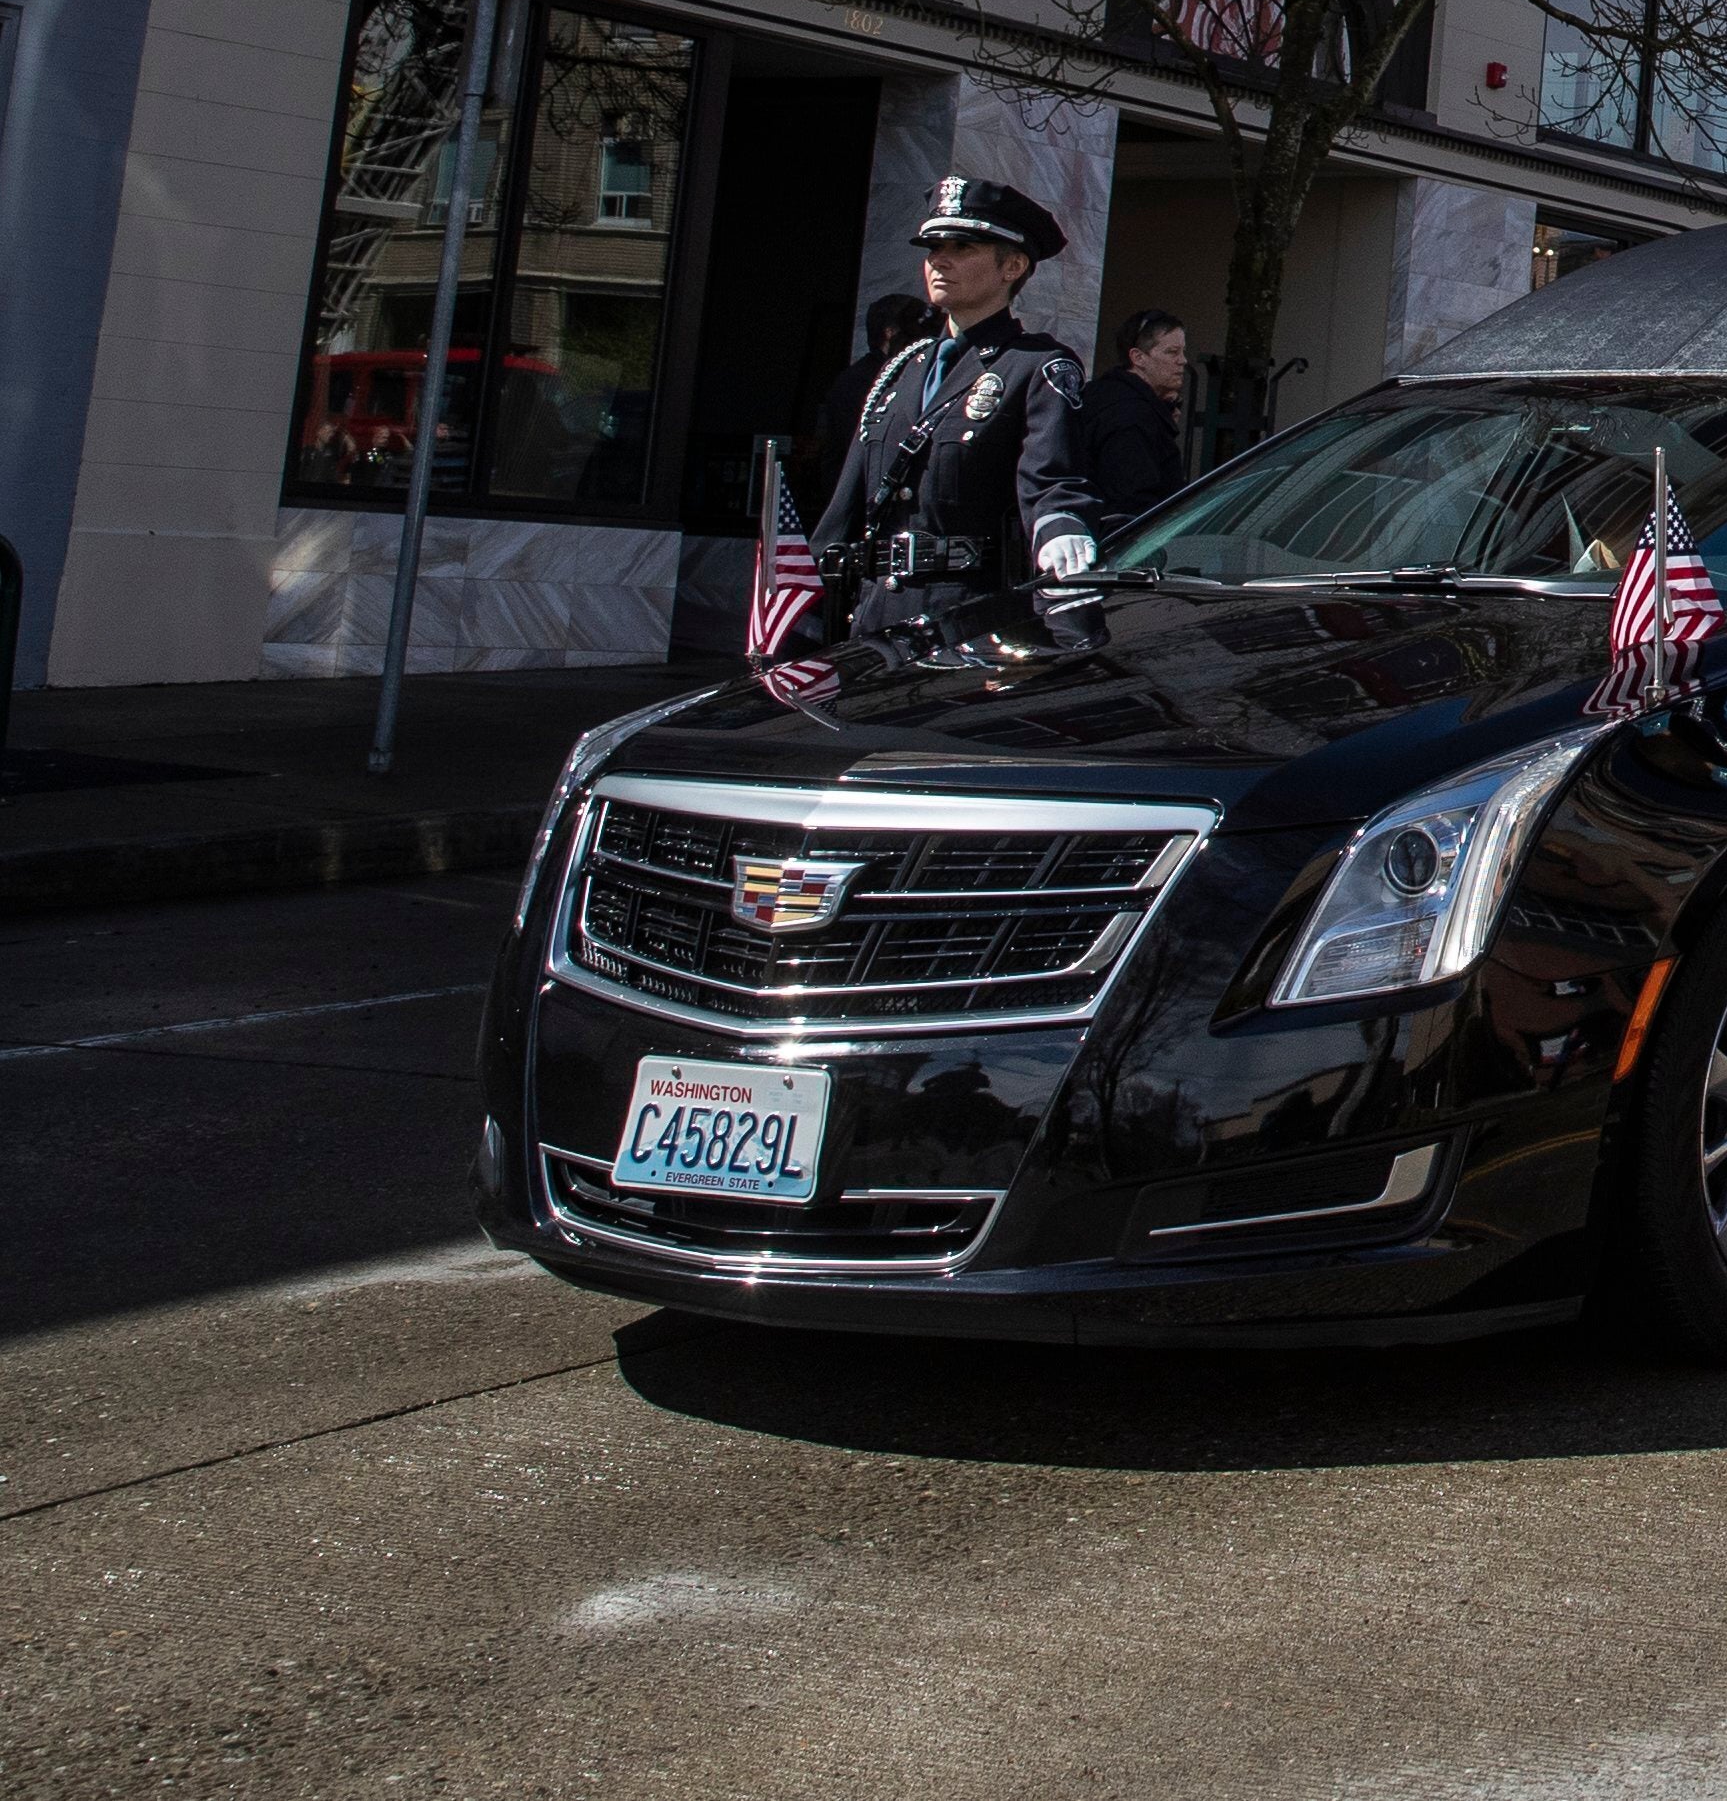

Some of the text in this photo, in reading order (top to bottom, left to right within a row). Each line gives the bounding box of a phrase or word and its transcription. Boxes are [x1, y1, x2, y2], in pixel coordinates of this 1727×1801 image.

[651, 1080, 753, 1104] WASHINGTON
[631, 1102, 804, 1178] C45829L
[665, 1172, 760, 1191] EVERGREEN STATE
